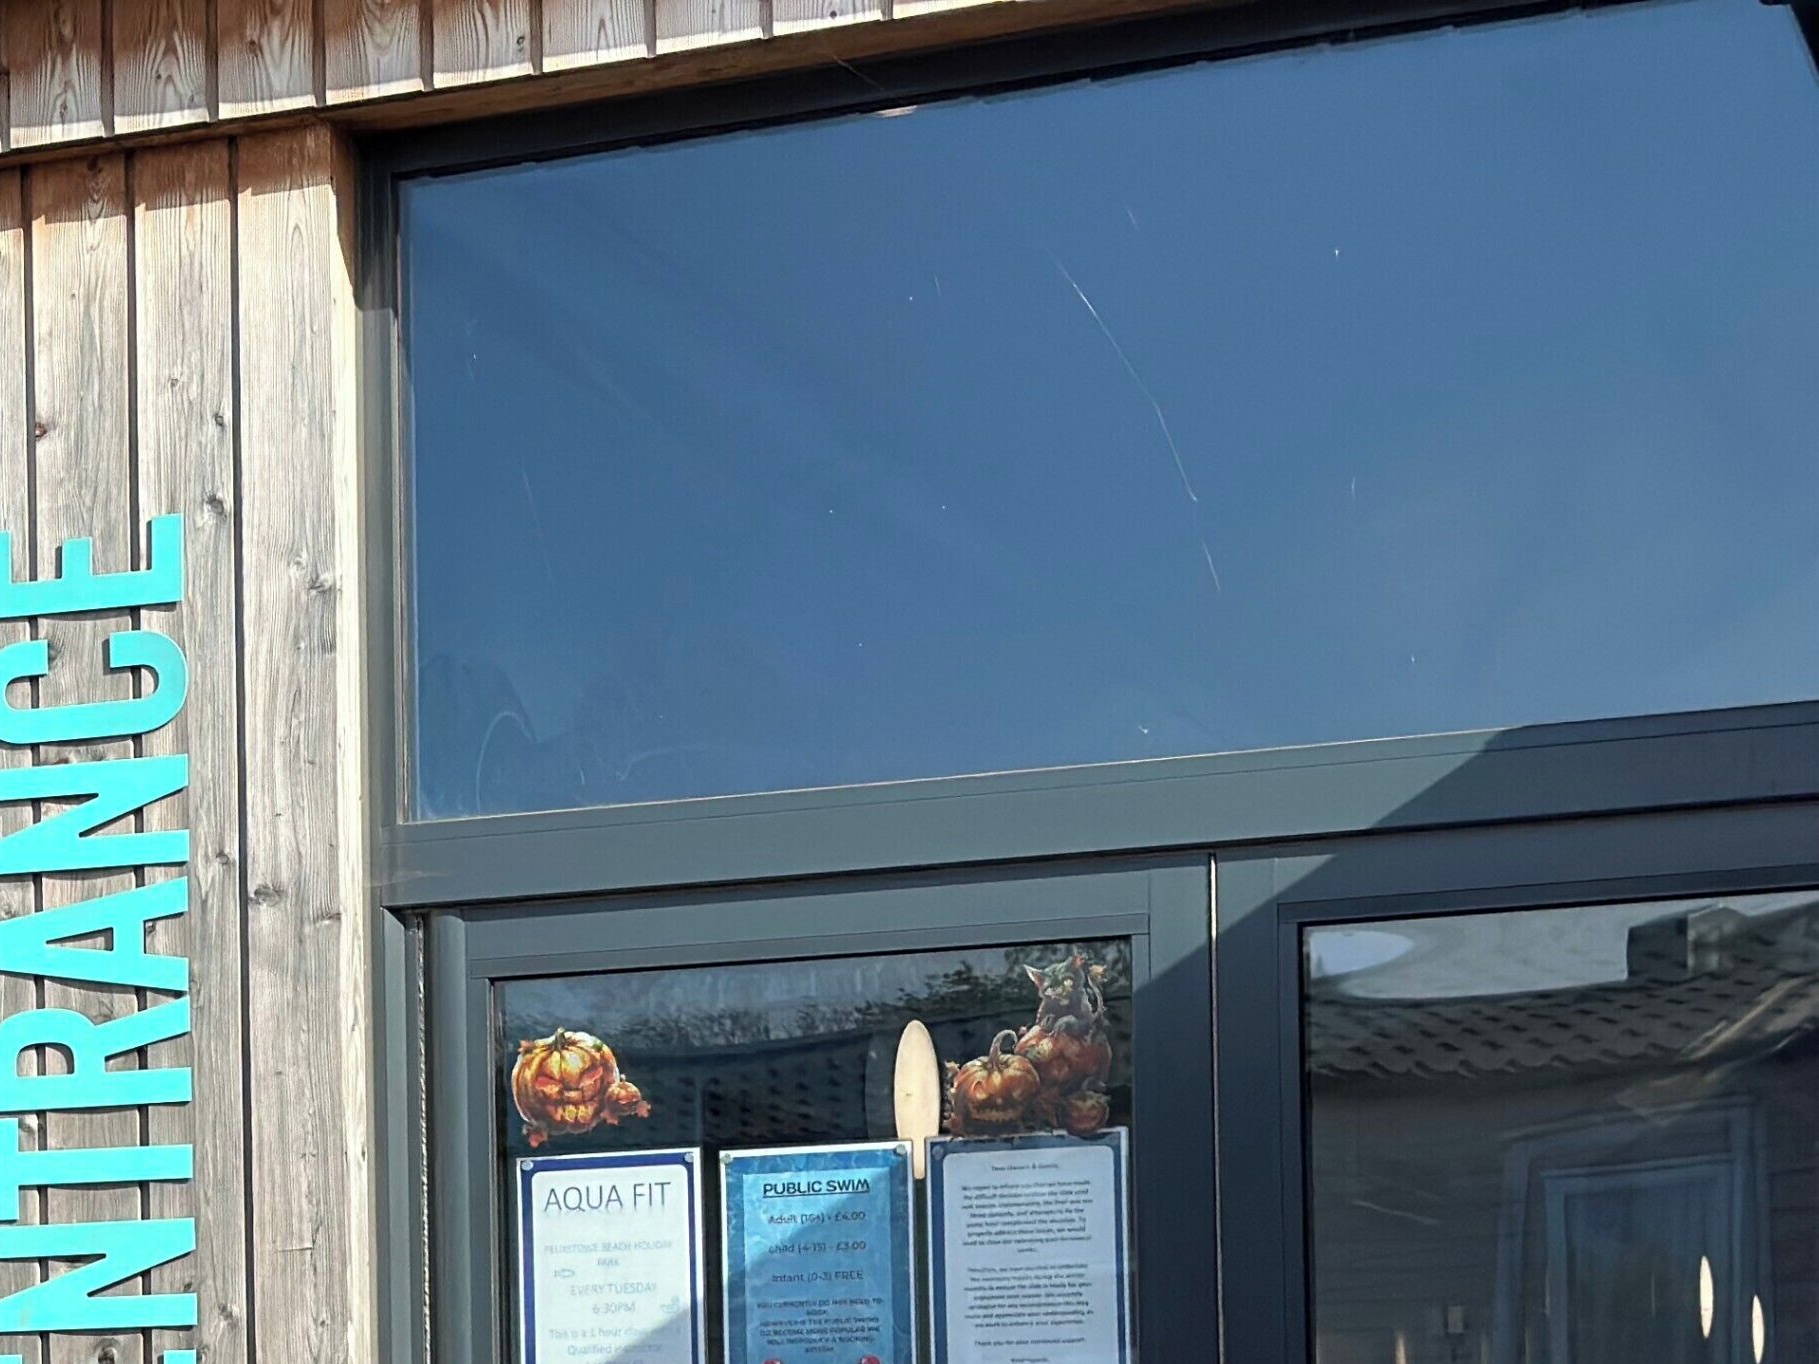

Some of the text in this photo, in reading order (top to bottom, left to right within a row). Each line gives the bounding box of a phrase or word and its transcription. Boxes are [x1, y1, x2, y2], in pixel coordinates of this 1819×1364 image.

[763, 1178, 870, 1197] PUBLIC SWIM
[544, 1182, 671, 1212] AQUA FIT
[834, 1270, 865, 1281] FREE
[608, 1282, 657, 1295] TUESDAY
